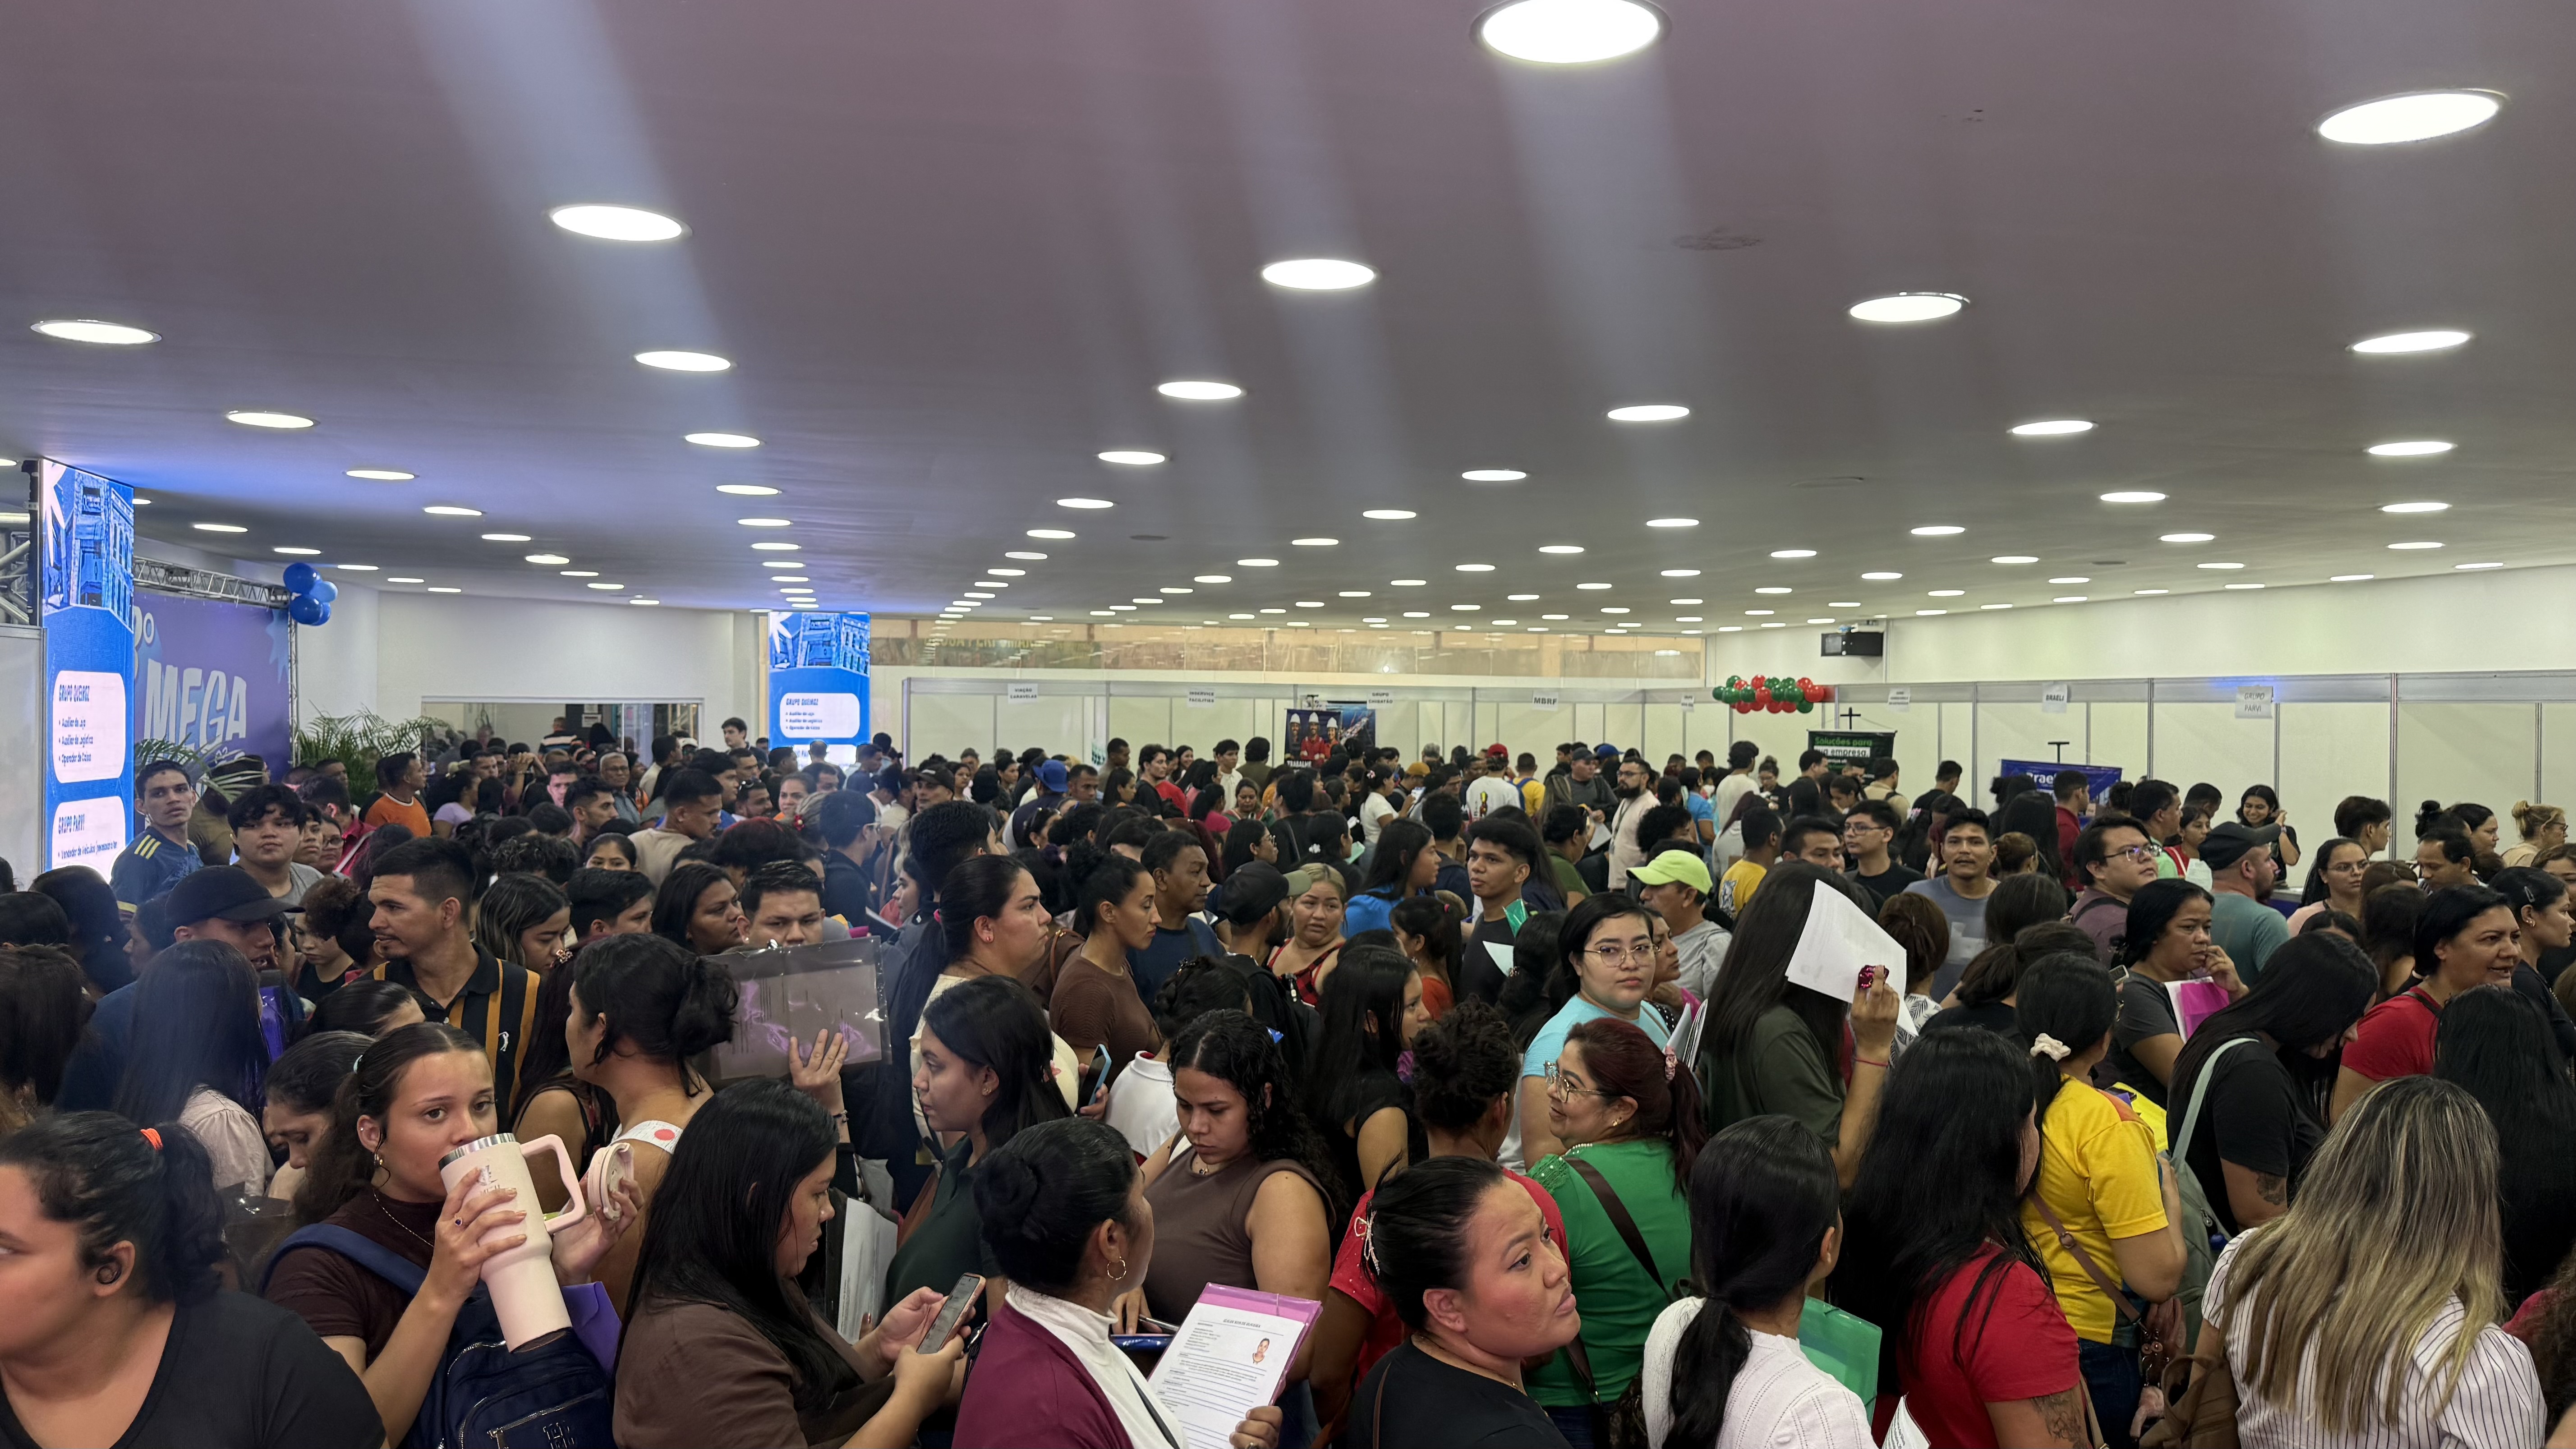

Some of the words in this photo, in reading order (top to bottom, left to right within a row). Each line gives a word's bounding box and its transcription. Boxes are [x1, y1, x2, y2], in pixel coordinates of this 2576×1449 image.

[59, 684, 73, 702] GRUPO
[74, 685, 90, 702] QUEIROZ
[143, 658, 247, 755] MEGA
[75, 718, 78, 727] de
[75, 735, 78, 745] de
[1815, 736, 1850, 746] Soluções
[62, 752, 77, 767] Operador
[78, 751, 81, 762] de
[58, 815, 72, 834] GRUPO
[73, 814, 85, 832] PARVI
[61, 847, 77, 859] Vendedor
[78, 846, 82, 856] de
